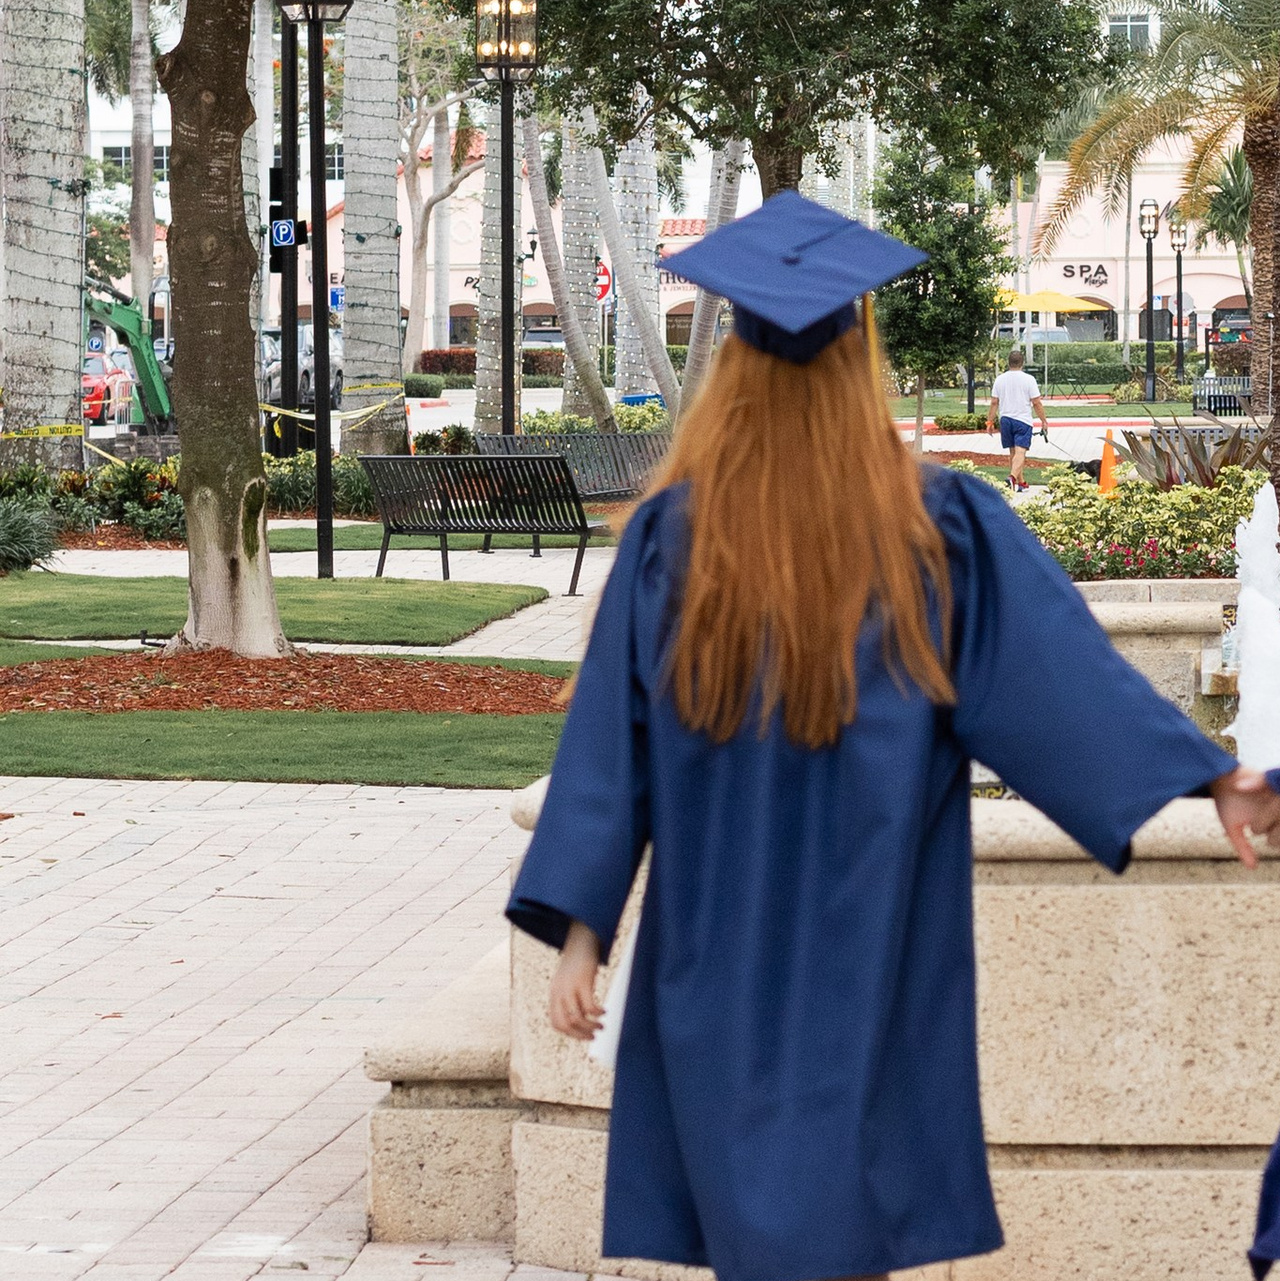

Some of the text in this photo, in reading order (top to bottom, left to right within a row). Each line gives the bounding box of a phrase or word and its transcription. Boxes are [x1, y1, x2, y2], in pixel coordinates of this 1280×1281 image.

[279, 225, 289, 241] P
[1063, 264, 1108, 278] SPA
[49, 426, 73, 435] CAUTION
